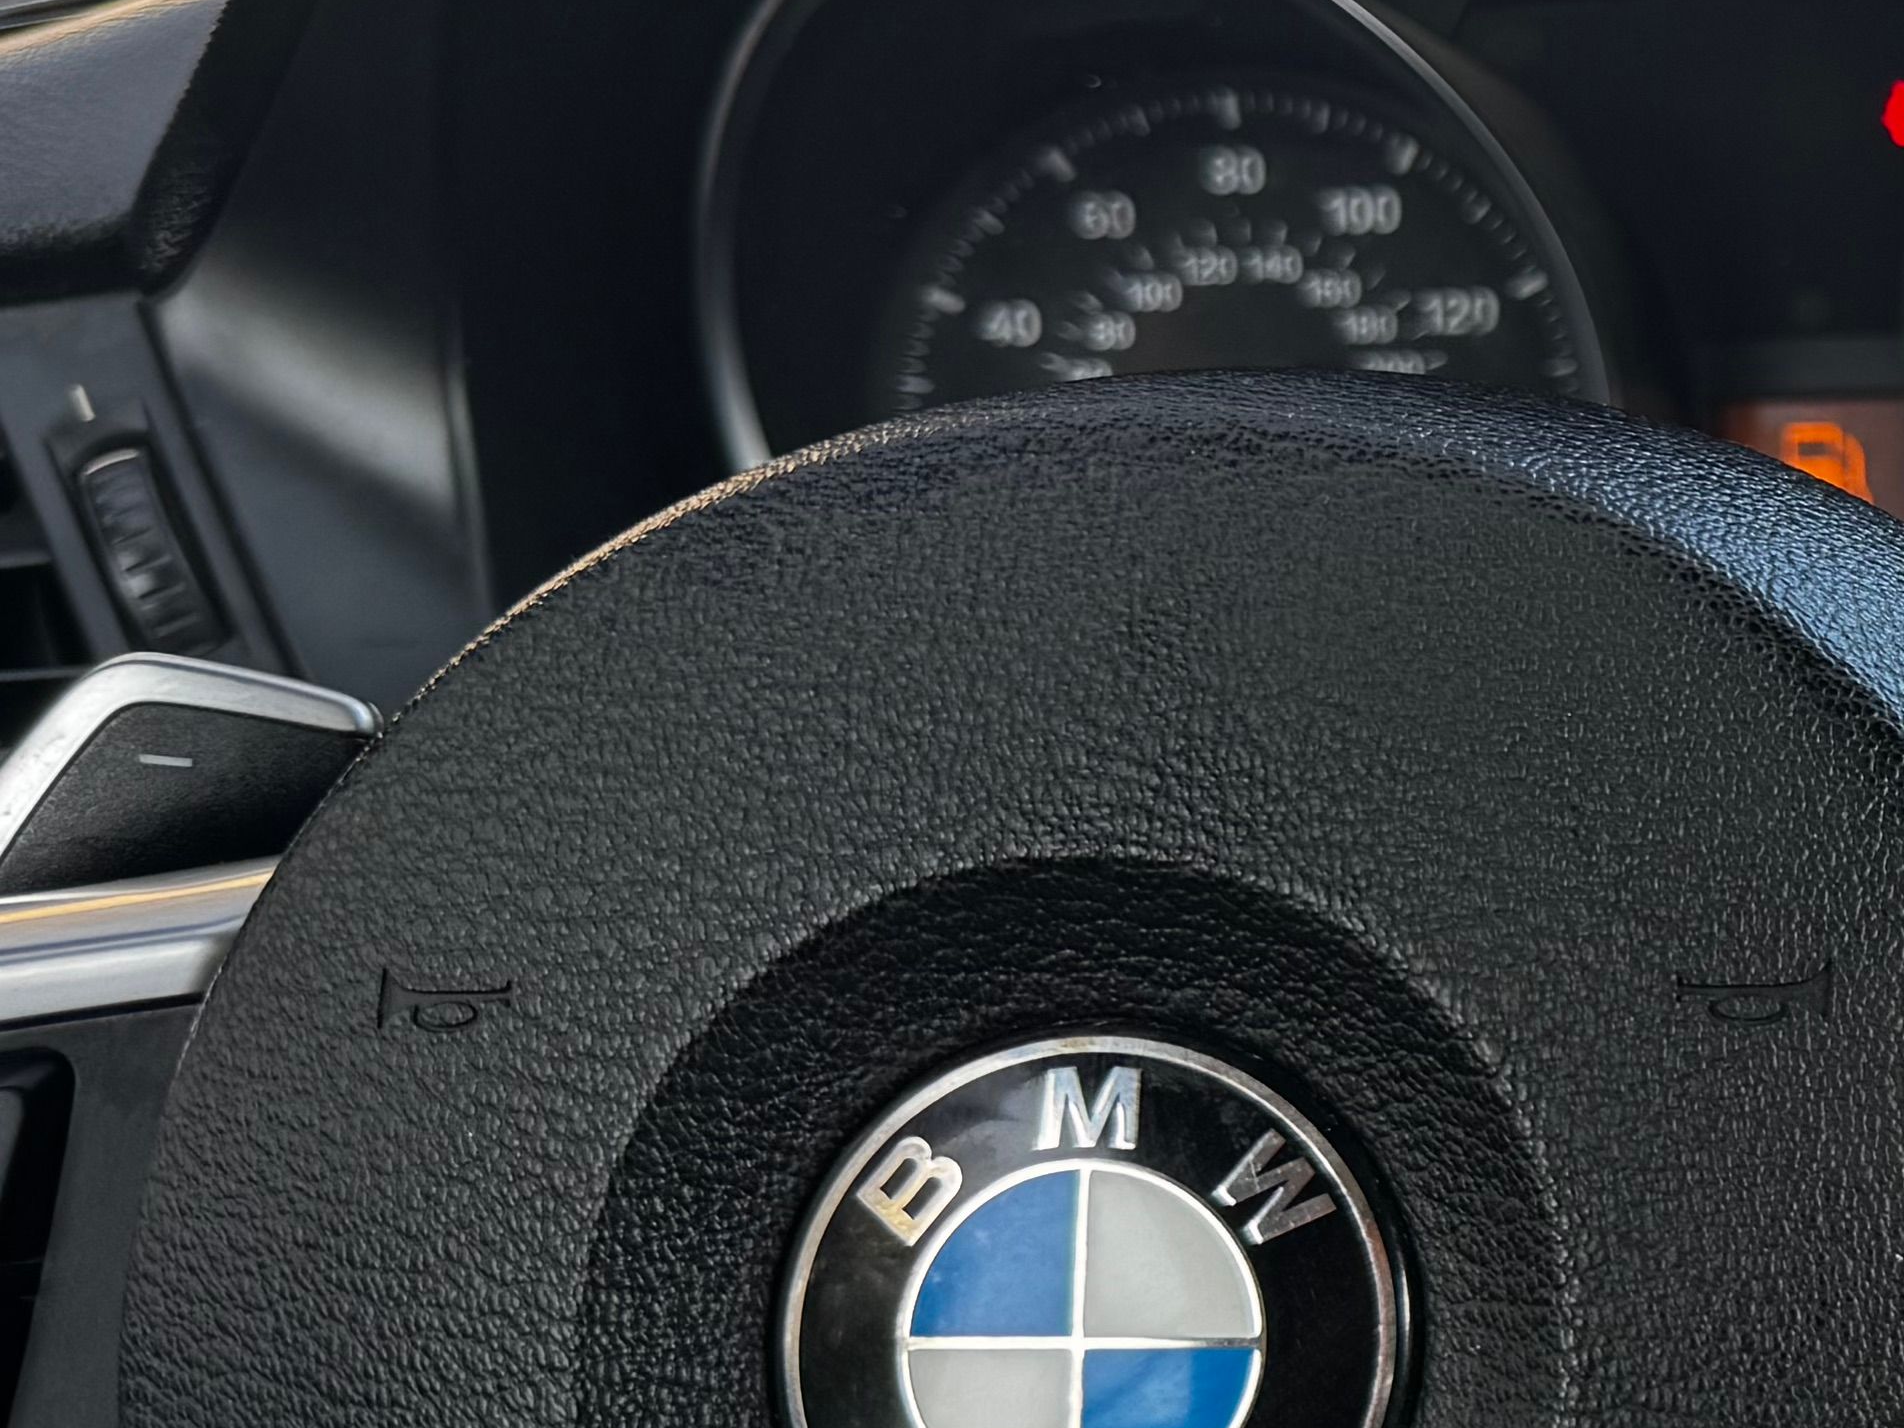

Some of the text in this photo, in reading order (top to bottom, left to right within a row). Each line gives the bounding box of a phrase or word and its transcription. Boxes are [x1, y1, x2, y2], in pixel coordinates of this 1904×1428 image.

[1202, 146, 1266, 195] 80
[1072, 191, 1136, 239] 60
[1320, 186, 1402, 236] 100
[1183, 246, 1238, 285] 120
[1125, 273, 1182, 312] 100
[1420, 287, 1499, 335] 120
[980, 299, 1042, 347] 40
[857, 1066, 1337, 1247] BMW
